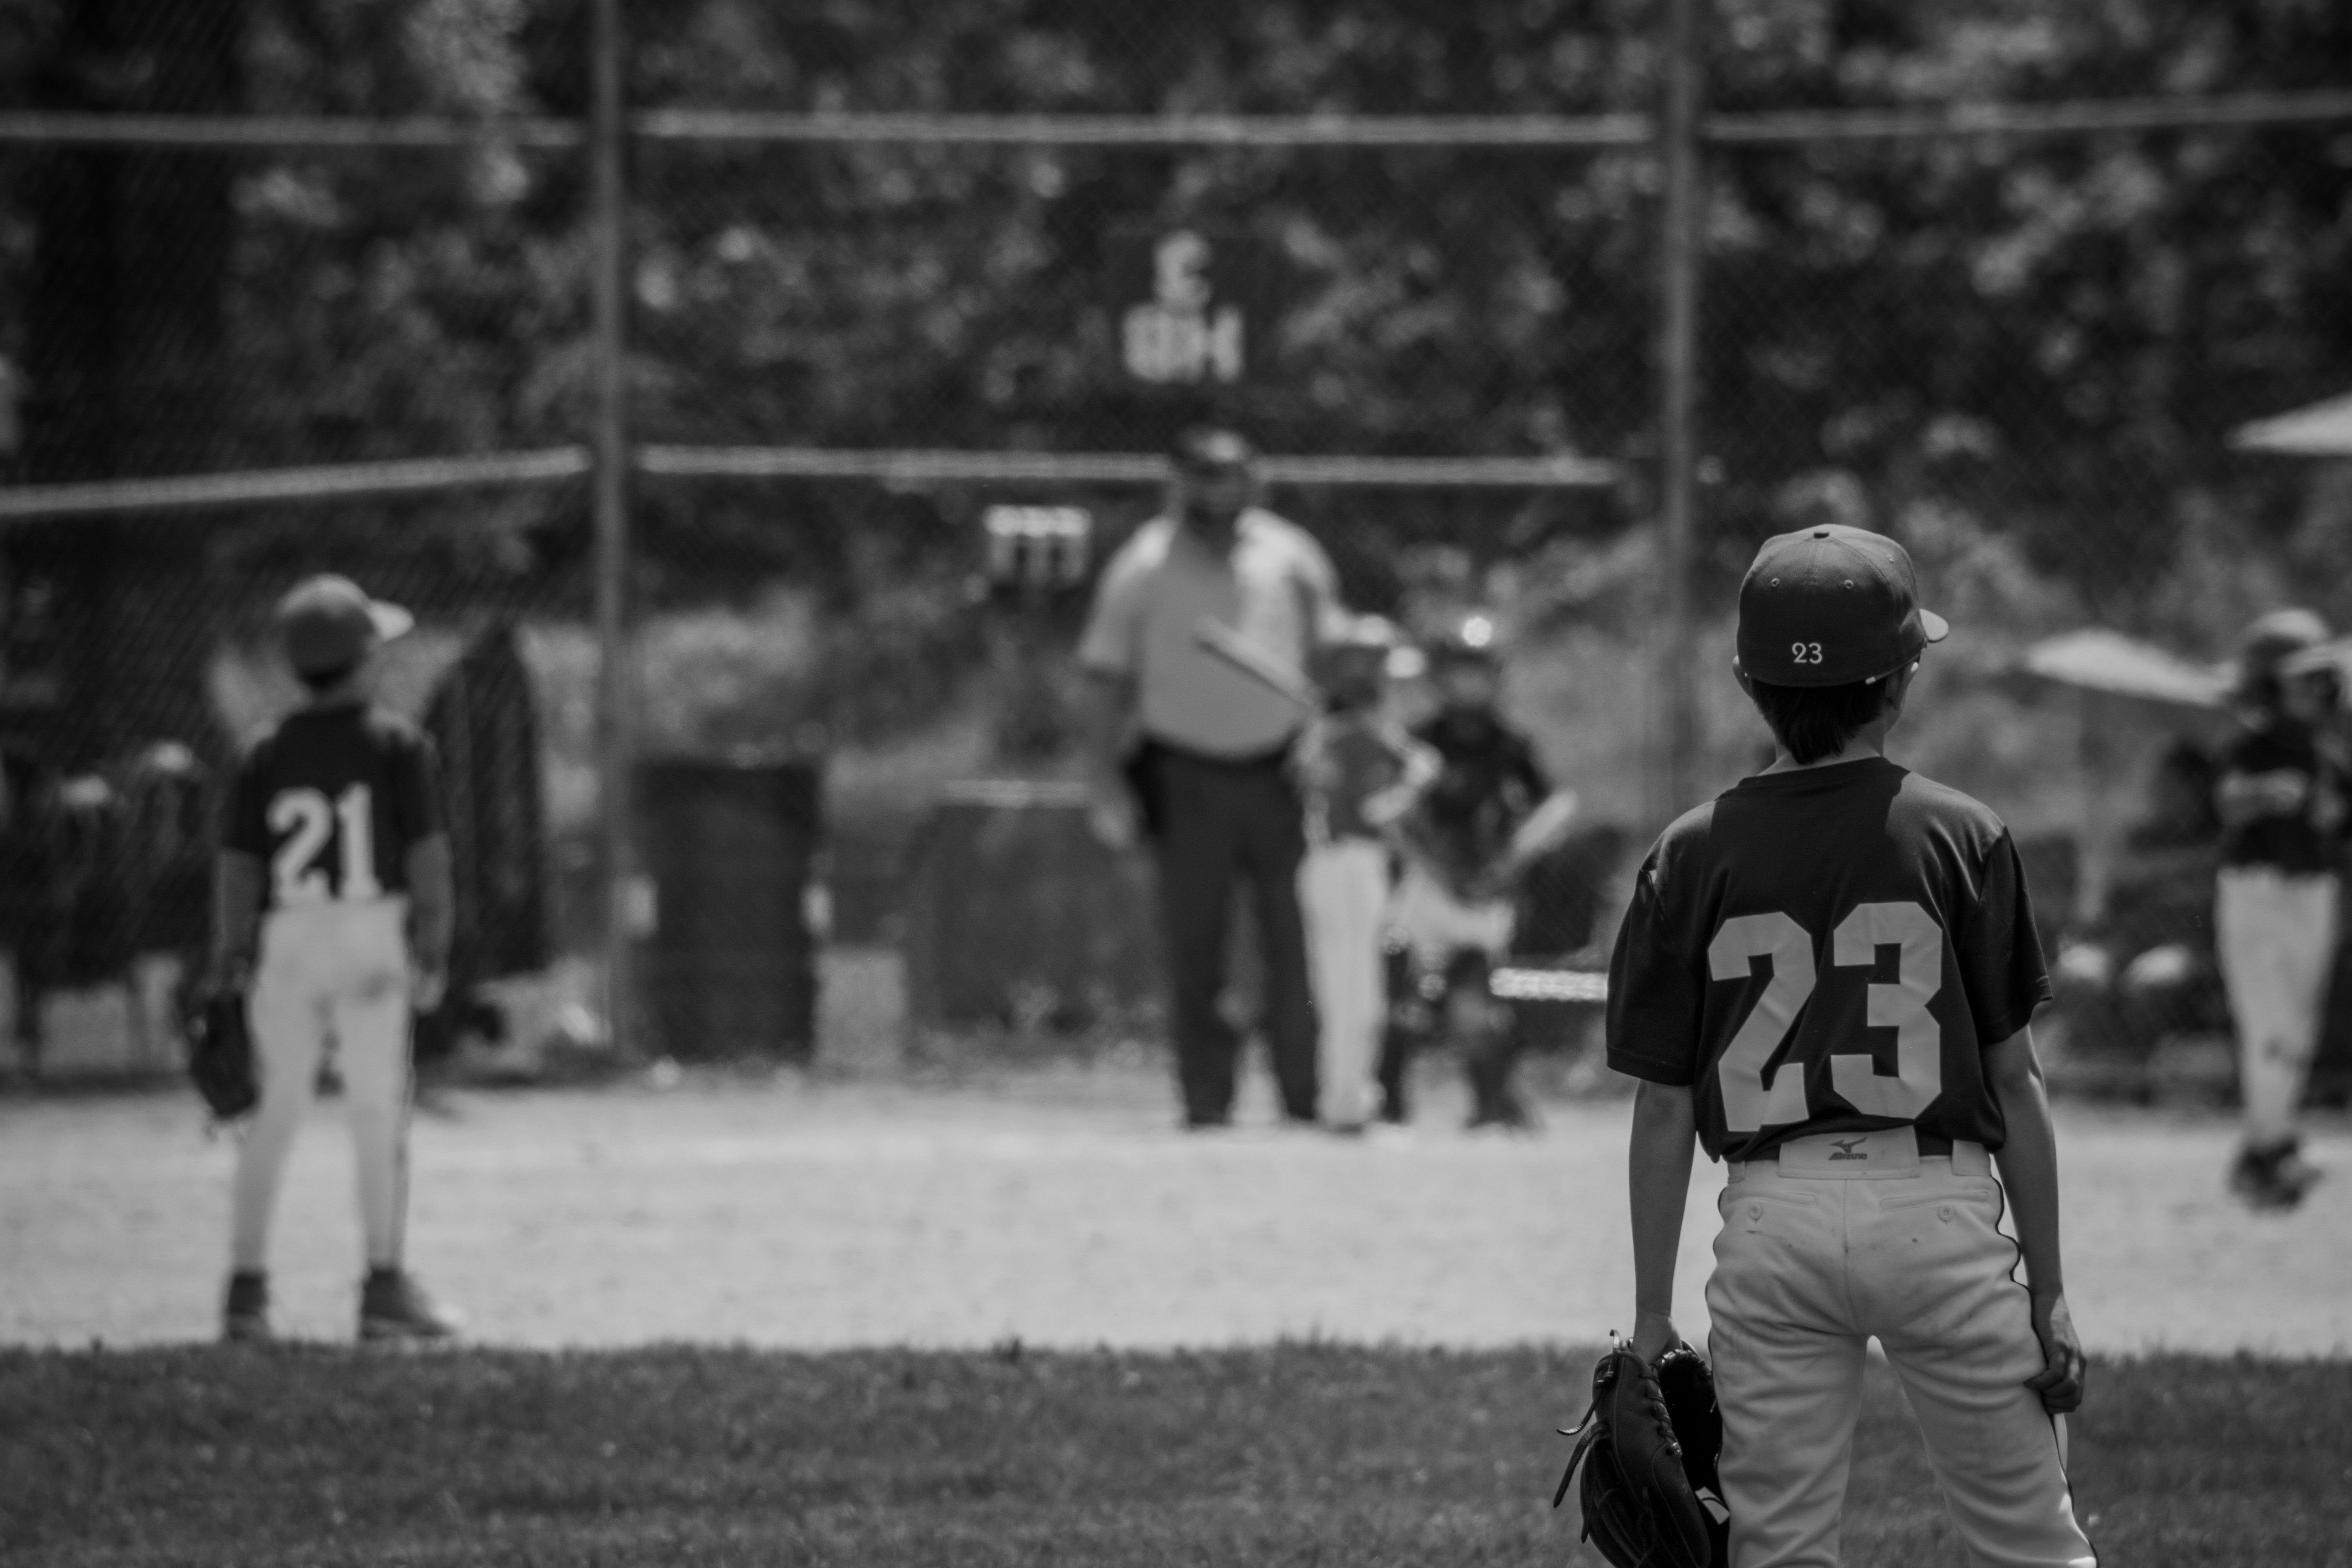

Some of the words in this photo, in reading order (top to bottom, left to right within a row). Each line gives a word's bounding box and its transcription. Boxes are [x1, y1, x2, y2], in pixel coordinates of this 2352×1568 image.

[1792, 642, 1823, 664] 23
[265, 782, 382, 903] 21
[1708, 901, 1943, 1132] 23
